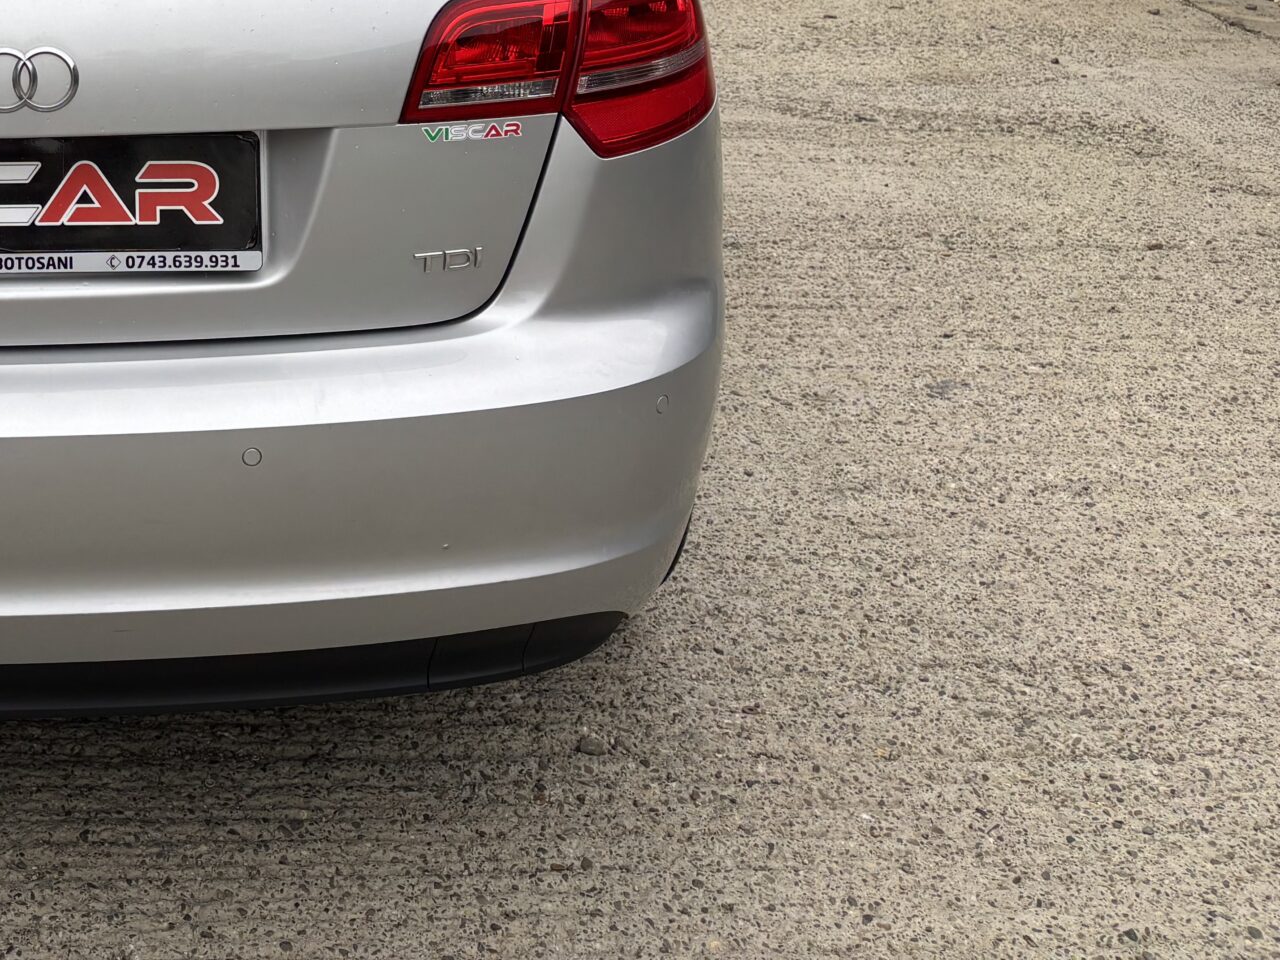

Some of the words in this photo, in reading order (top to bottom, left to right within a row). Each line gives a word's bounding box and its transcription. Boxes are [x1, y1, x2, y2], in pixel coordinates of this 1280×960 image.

[421, 121, 522, 143] VISCAR
[125, 254, 241, 270] 0743.639.931
[413, 246, 483, 273] TDI
